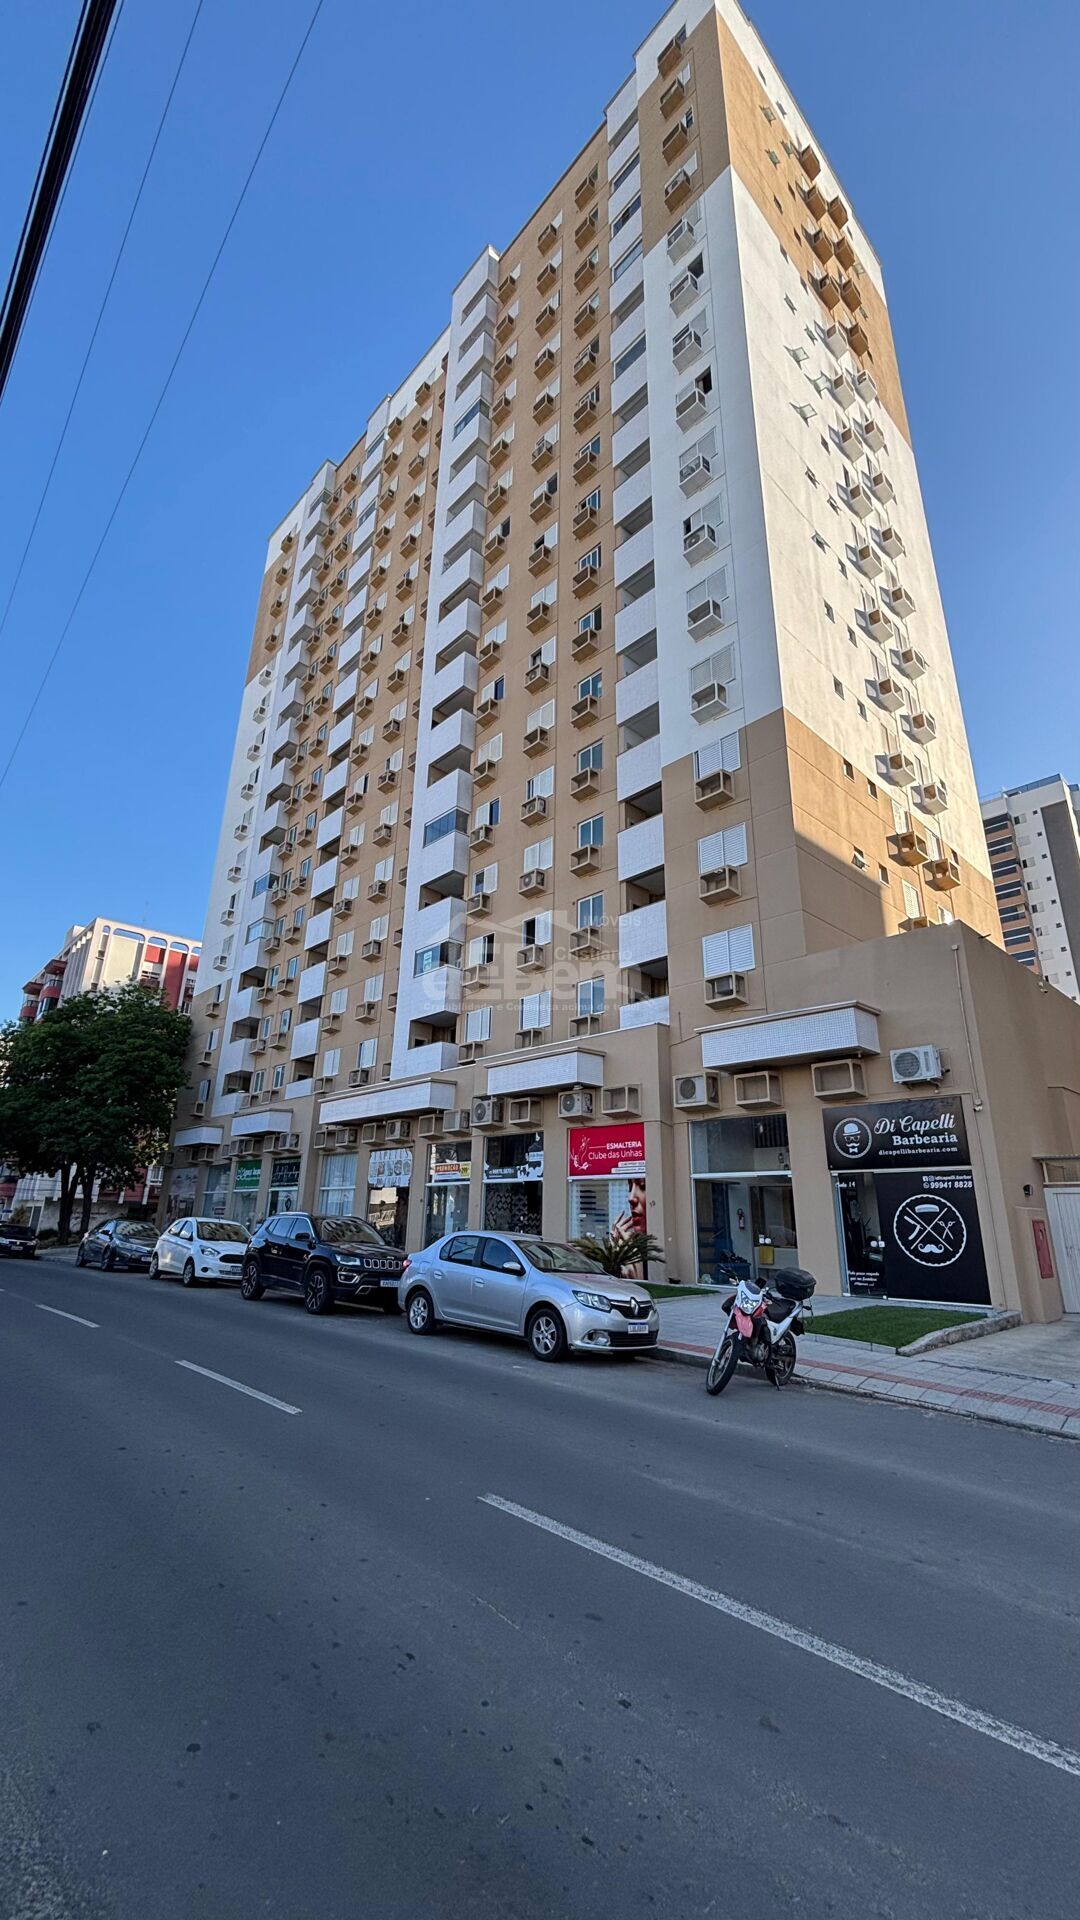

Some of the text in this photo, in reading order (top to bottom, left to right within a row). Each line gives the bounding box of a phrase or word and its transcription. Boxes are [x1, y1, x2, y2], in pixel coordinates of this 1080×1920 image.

[873, 1113, 955, 1135] Di Capelli
[606, 1140, 642, 1150] ESMALTERIA
[892, 1133, 958, 1146] Barbearia
[588, 1149, 643, 1160] Clube das Unhas
[930, 1180, 973, 1189] 99941 8828
